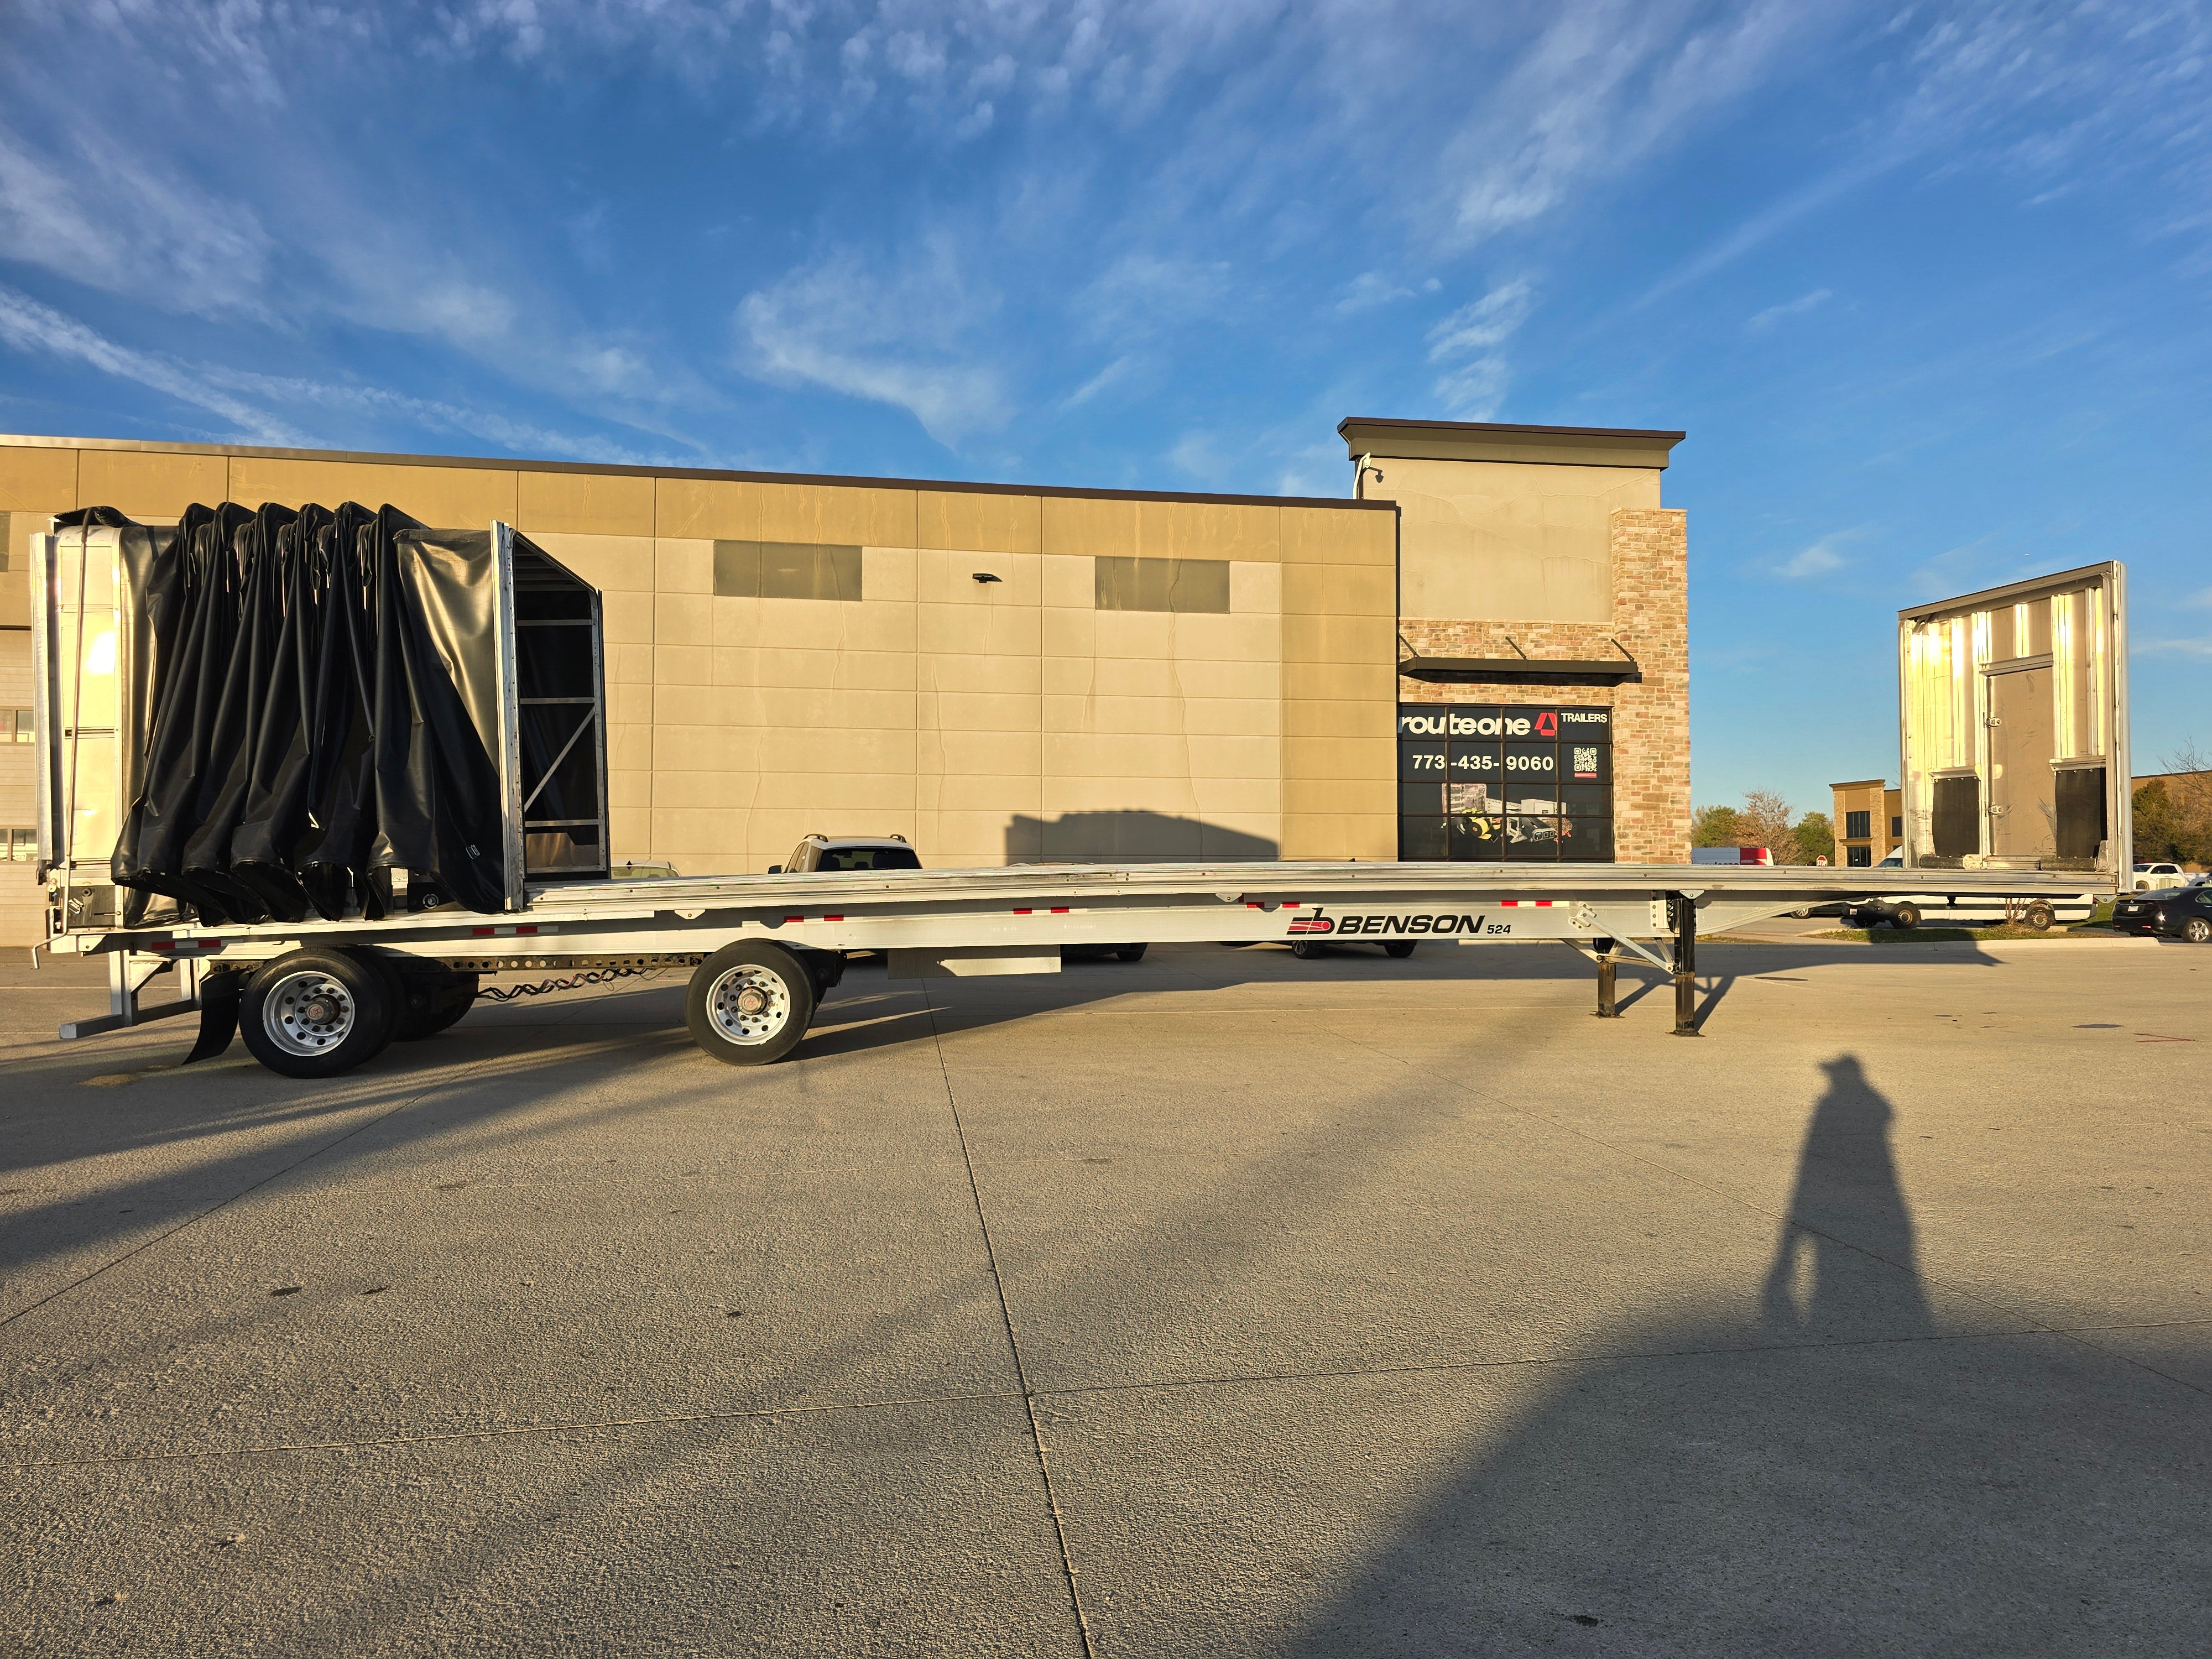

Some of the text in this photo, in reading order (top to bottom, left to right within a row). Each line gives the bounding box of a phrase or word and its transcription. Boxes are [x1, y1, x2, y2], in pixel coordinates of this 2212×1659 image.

[1397, 713, 1531, 735] routeone
[1561, 713, 1608, 723] TRAILERS
[1335, 915, 1485, 935] BENSON
[1486, 925, 1511, 935] 524
